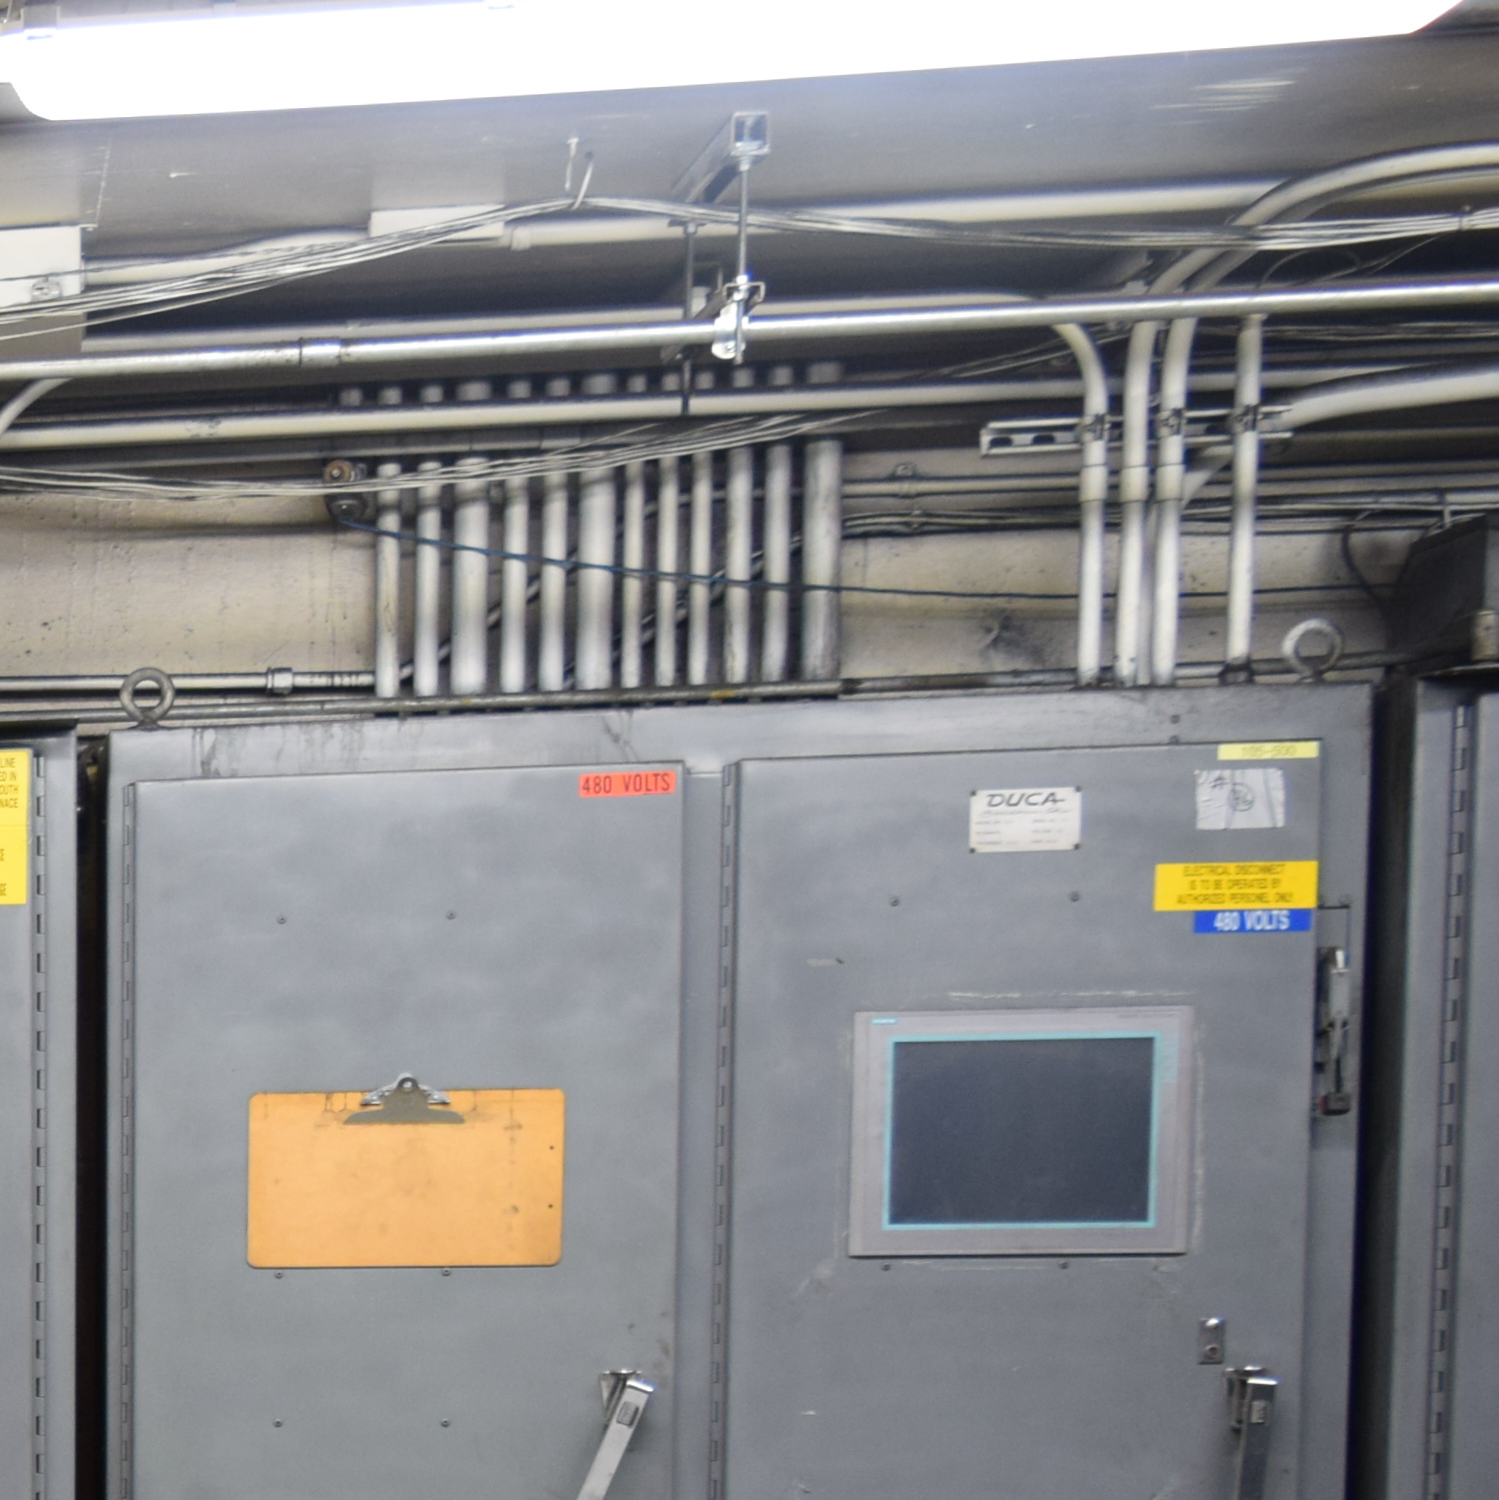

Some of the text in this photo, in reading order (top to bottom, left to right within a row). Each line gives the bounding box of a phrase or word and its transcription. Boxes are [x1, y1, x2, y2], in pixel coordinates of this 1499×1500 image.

[9, 770, 17, 781] IN
[583, 772, 670, 794] 480 VOLTS
[985, 792, 1066, 807] DUCA
[1213, 909, 1291, 931] 480 VOLTS
